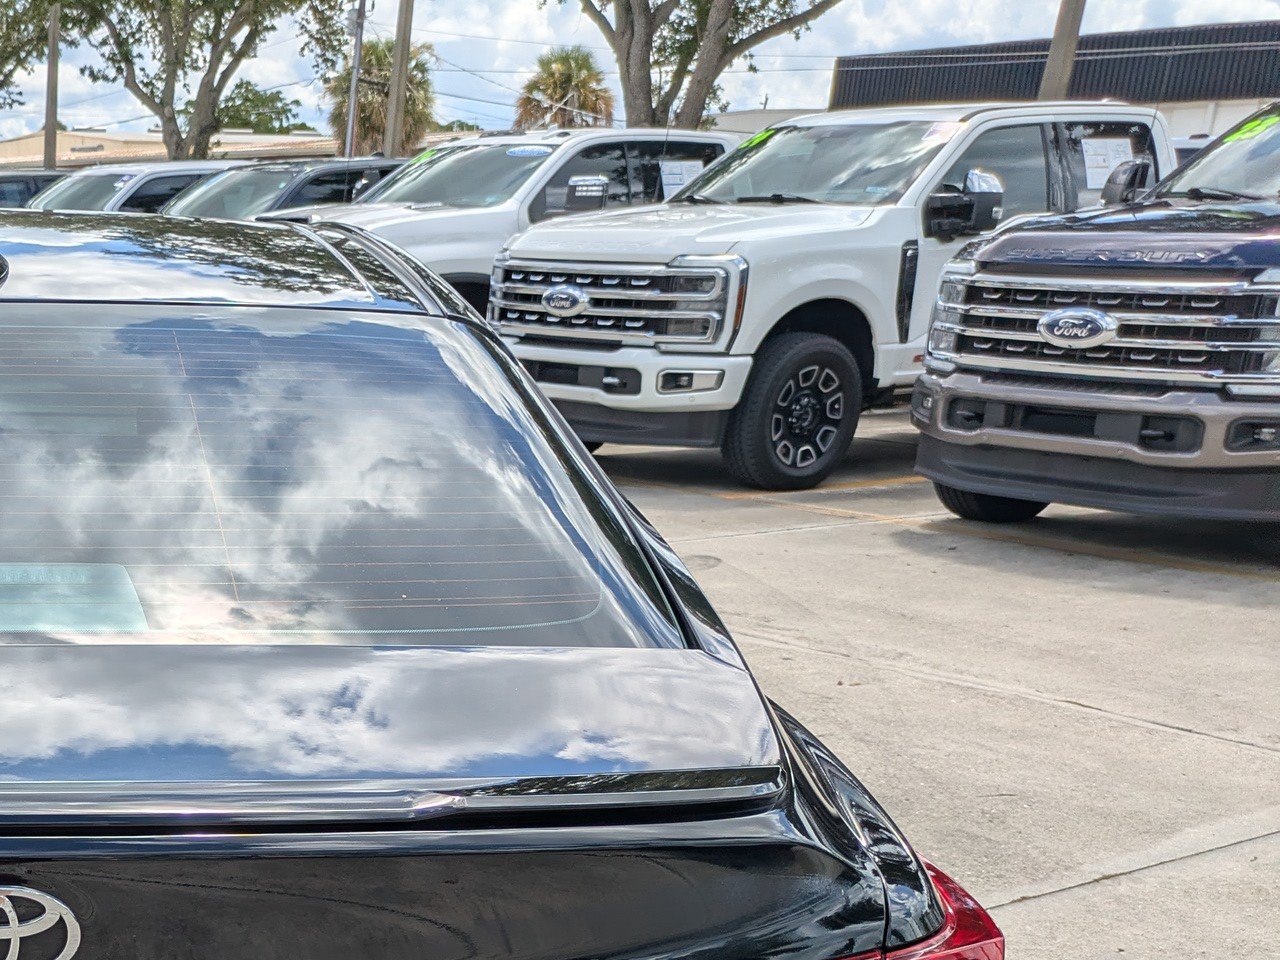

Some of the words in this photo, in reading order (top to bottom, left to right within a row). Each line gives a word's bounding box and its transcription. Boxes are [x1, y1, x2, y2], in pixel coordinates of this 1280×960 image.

[1007, 249, 1109, 261] SUPER
[1117, 250, 1219, 263] DUTY
[1053, 318, 1093, 338] Ford
